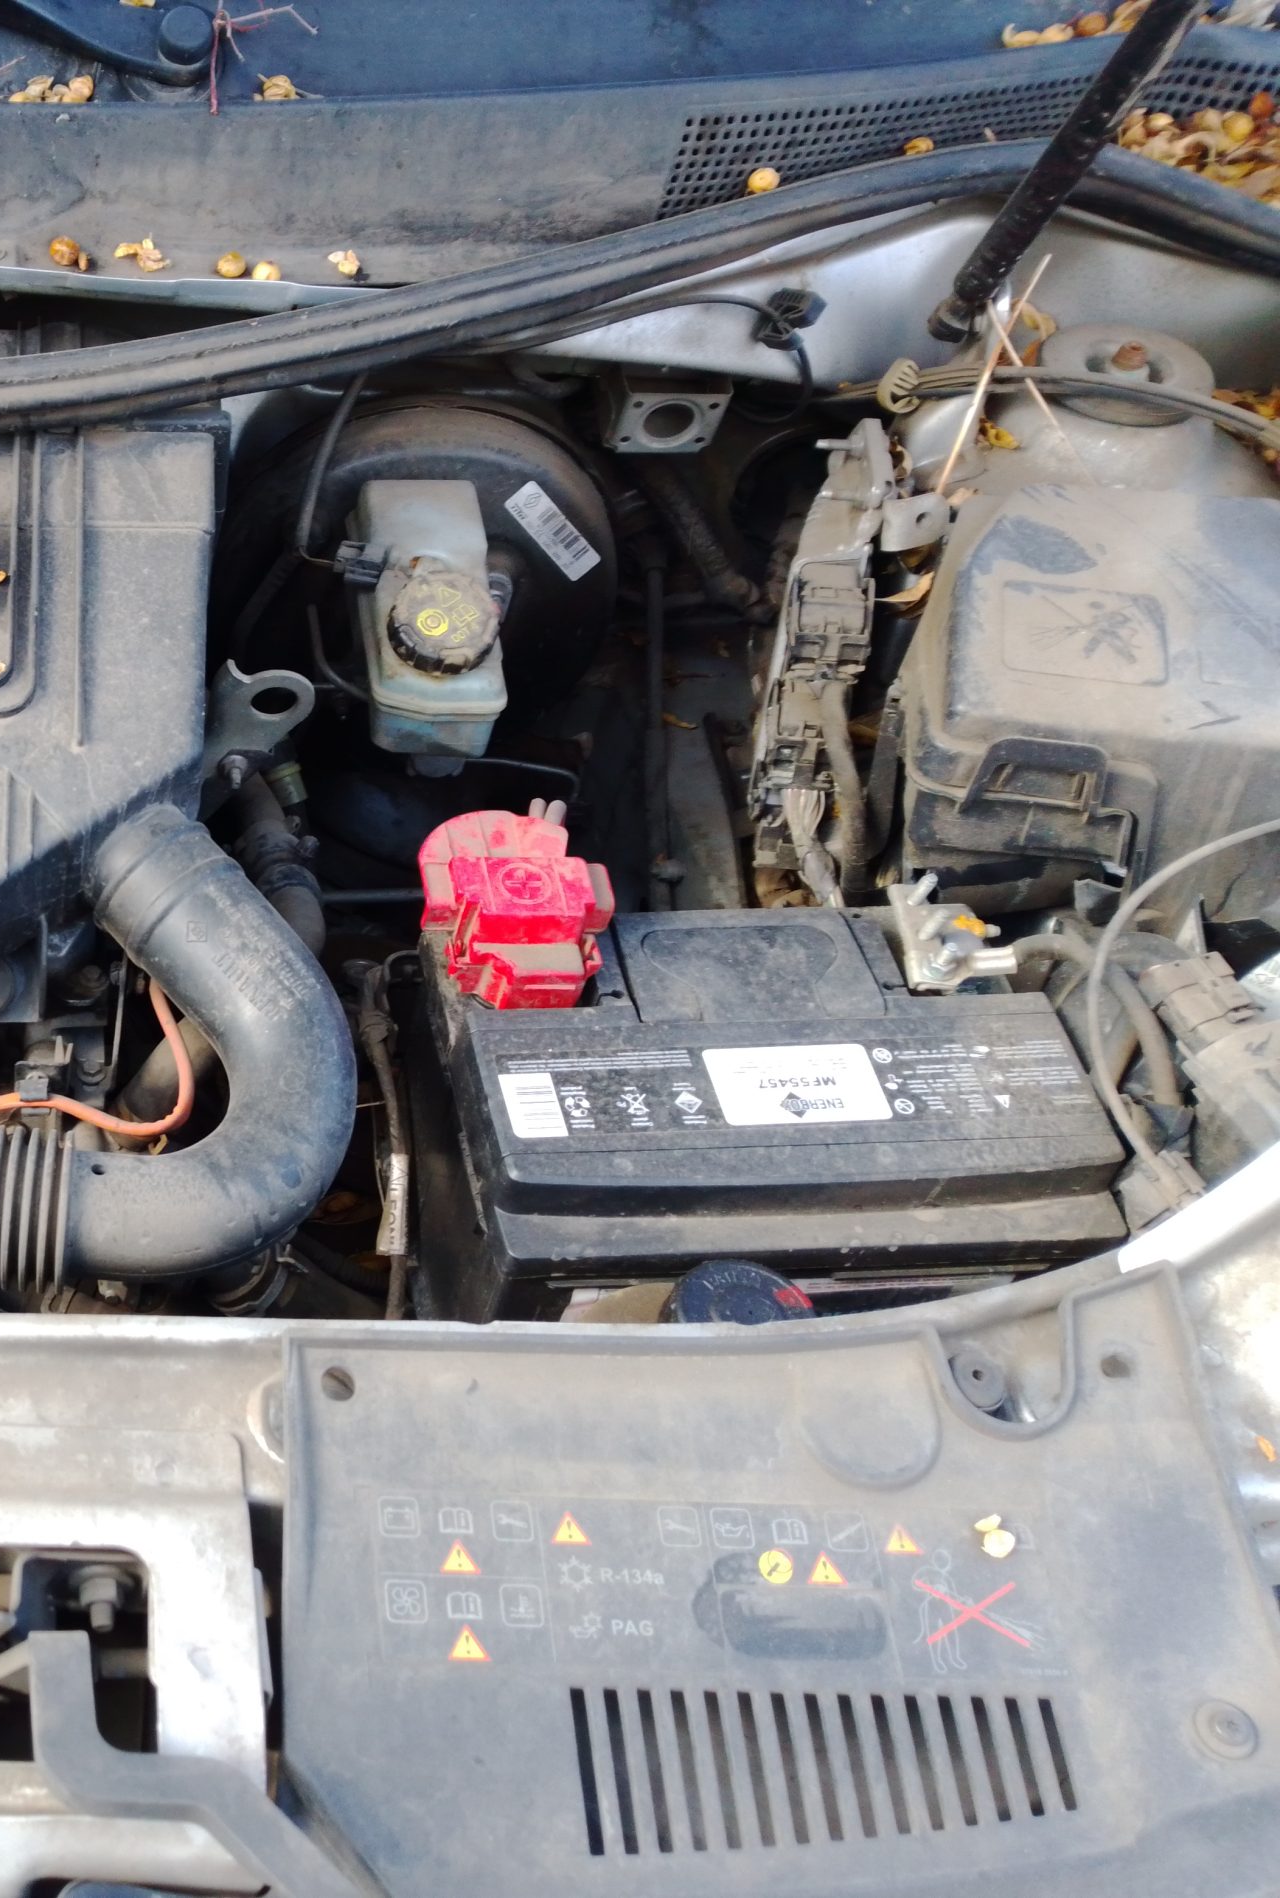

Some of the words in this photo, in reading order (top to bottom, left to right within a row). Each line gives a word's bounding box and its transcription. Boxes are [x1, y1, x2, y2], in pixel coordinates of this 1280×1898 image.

[758, 1075, 837, 1089] MF55457
[601, 1568, 665, 1586] R-134a
[612, 1619, 654, 1637] PAG
